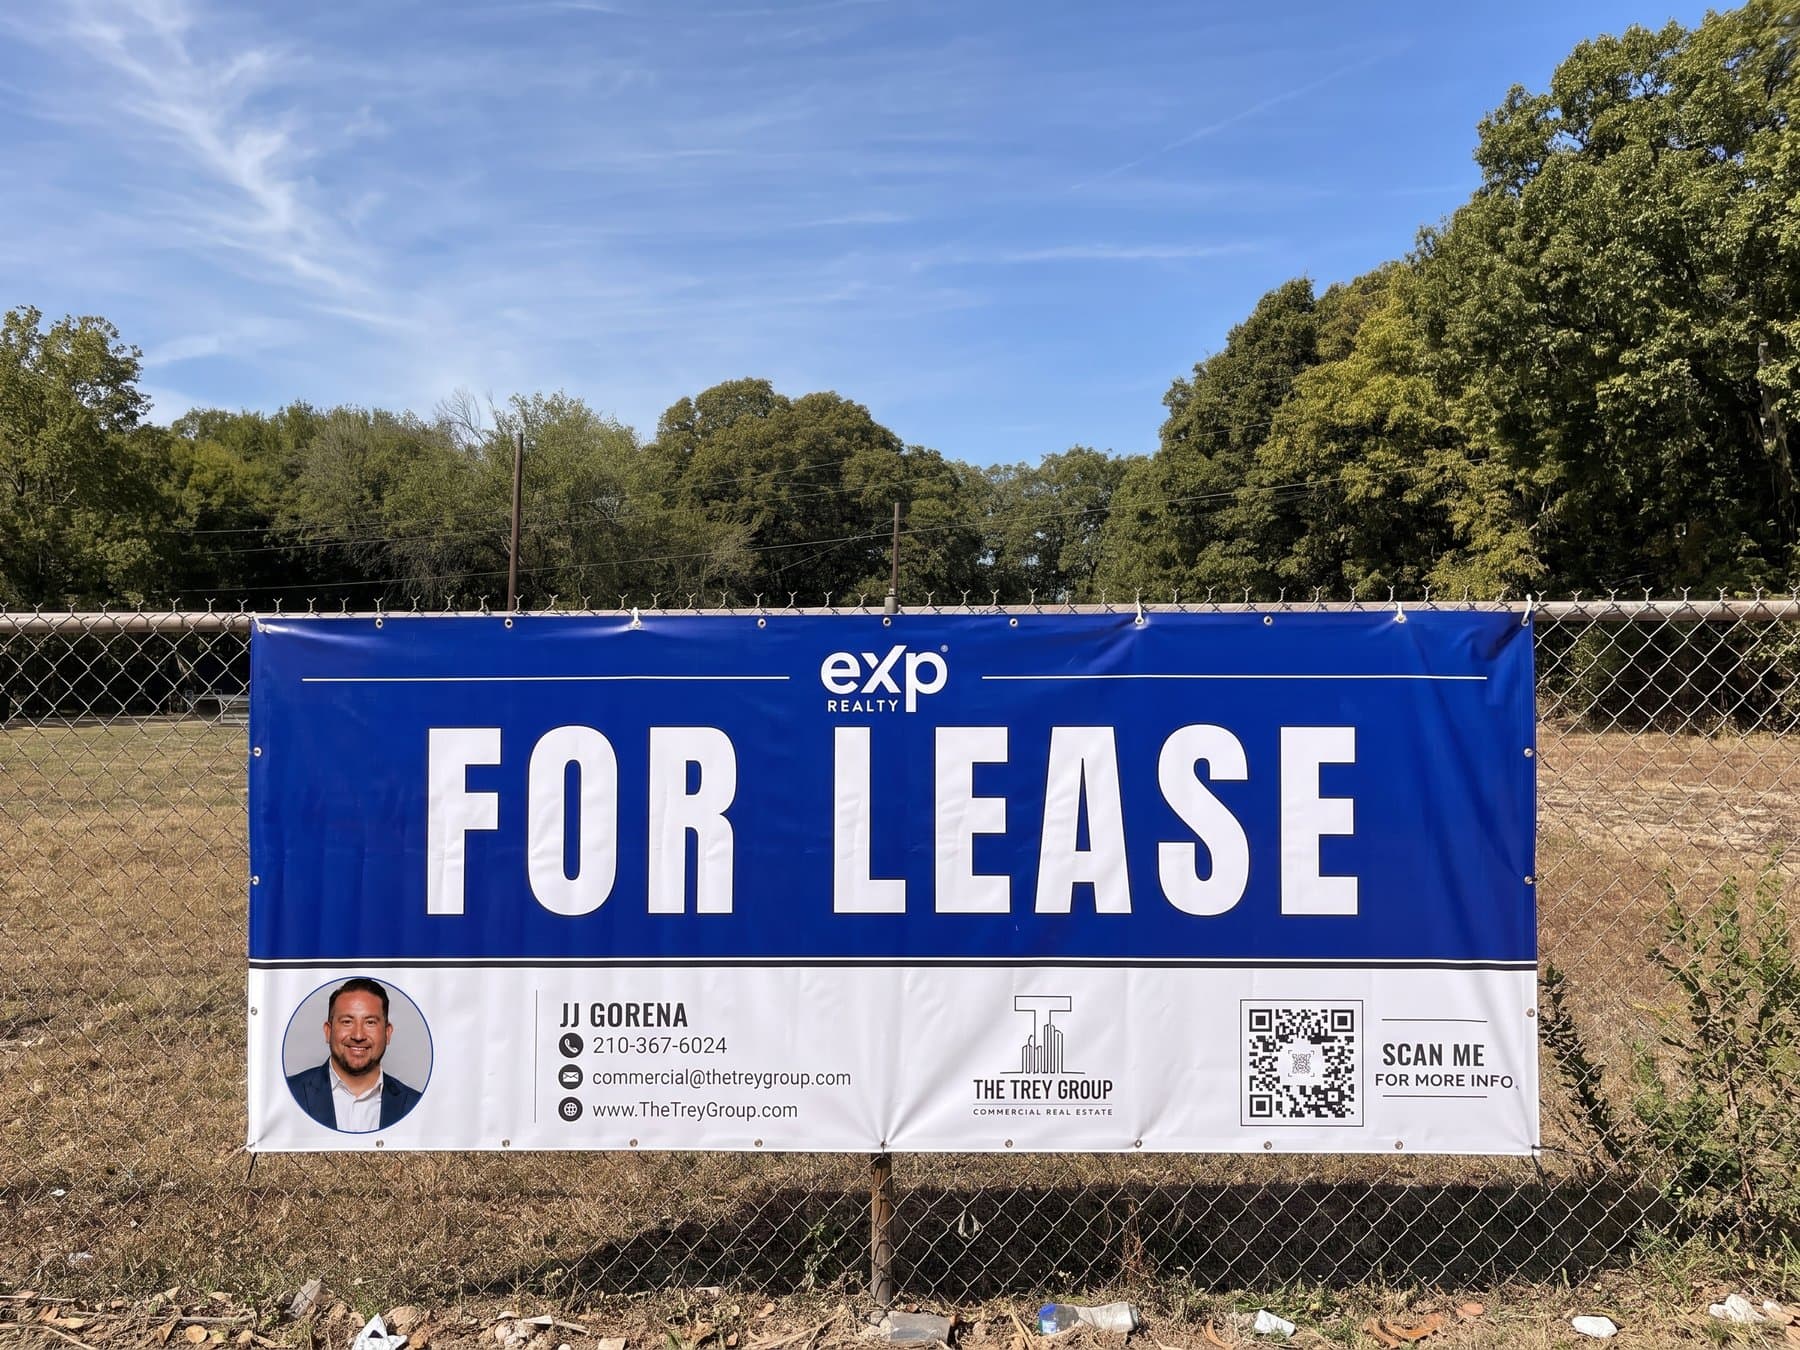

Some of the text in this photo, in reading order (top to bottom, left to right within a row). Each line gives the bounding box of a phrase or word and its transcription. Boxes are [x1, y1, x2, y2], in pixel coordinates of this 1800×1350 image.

[827, 699, 899, 713] REALTY
[427, 724, 1358, 916] FOR LEASE
[559, 1002, 689, 1028] JJ GORENA
[593, 1036, 728, 1054] 210-367-6024
[1382, 1042, 1485, 1067] SCAN ME
[592, 1068, 851, 1090] commercial@thetreygroup.com
[972, 1079, 1113, 1100] THE TREY GROUP
[1375, 1073, 1514, 1089] FOR MORE INFO
[592, 1100, 798, 1122] www.TheTreyGroup.com
[972, 1108, 1113, 1116] COMMERCIAL REAL ESTATE
